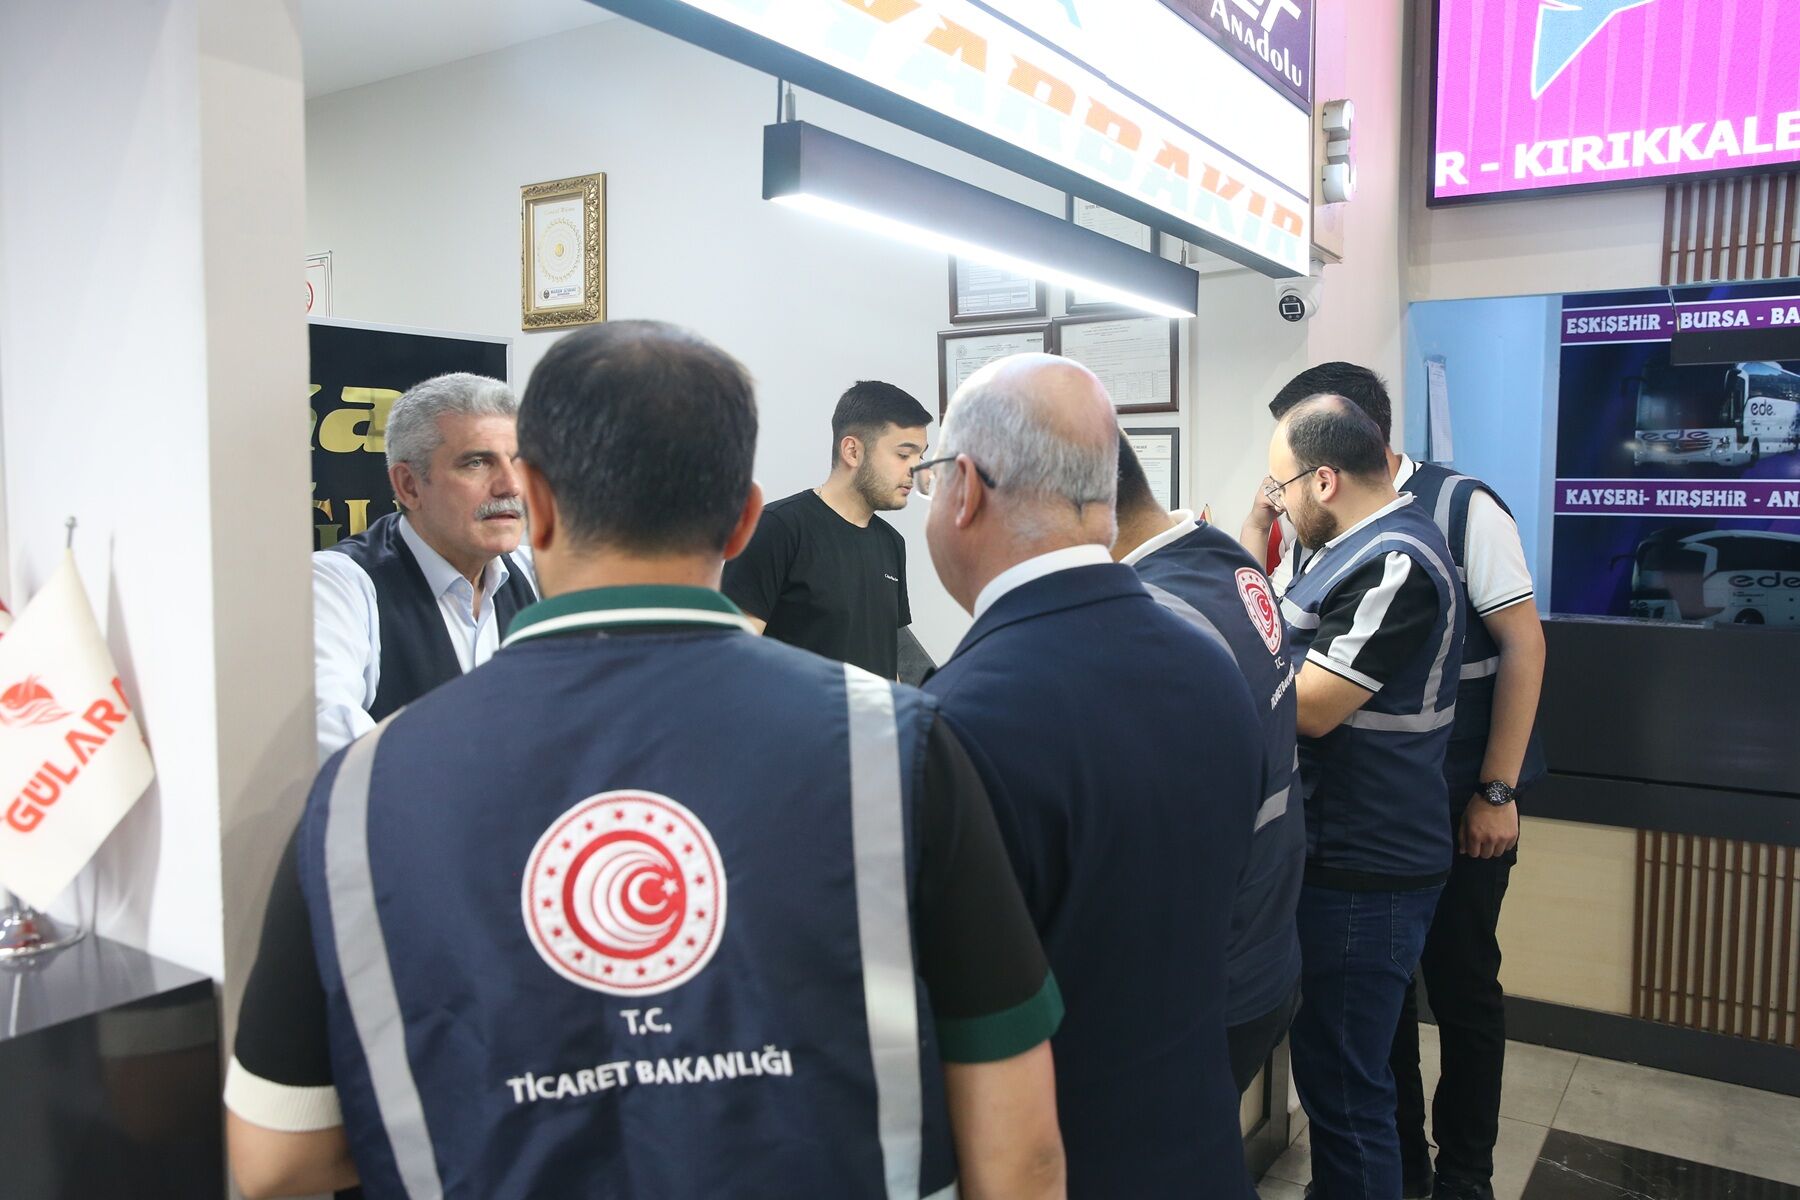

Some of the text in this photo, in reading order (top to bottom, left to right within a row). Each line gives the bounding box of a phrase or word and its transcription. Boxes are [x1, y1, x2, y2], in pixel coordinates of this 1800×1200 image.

[1514, 111, 1800, 179] KIRIKKALE
[1680, 309, 1751, 329] BURSA
[620, 1007, 672, 1035] T.C.
[506, 1044, 793, 1103] TİCARET BAKANLIĞI
